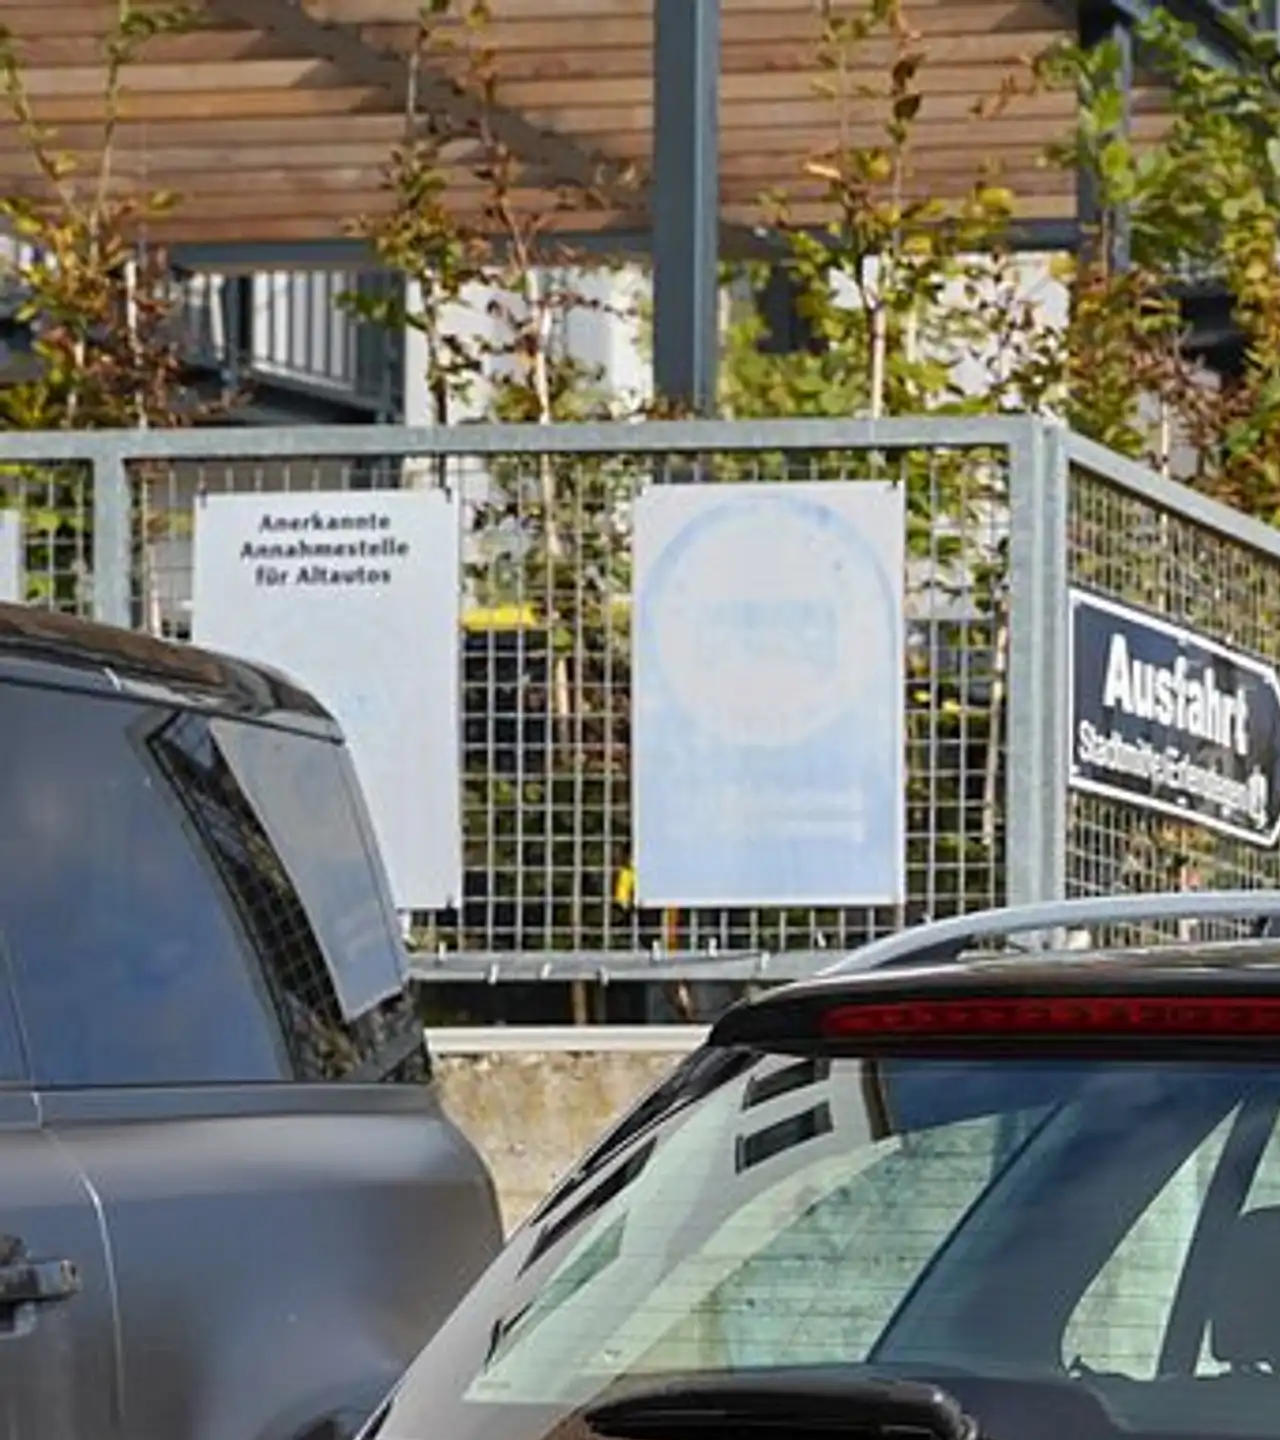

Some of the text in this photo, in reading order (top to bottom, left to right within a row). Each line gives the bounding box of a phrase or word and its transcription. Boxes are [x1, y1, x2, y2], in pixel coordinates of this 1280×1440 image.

[259, 511, 391, 532] Anerkannte
[240, 535, 410, 559] Annahmestelle
[255, 564, 391, 585] für Altautos
[1103, 633, 1249, 755] Ausfahrt
